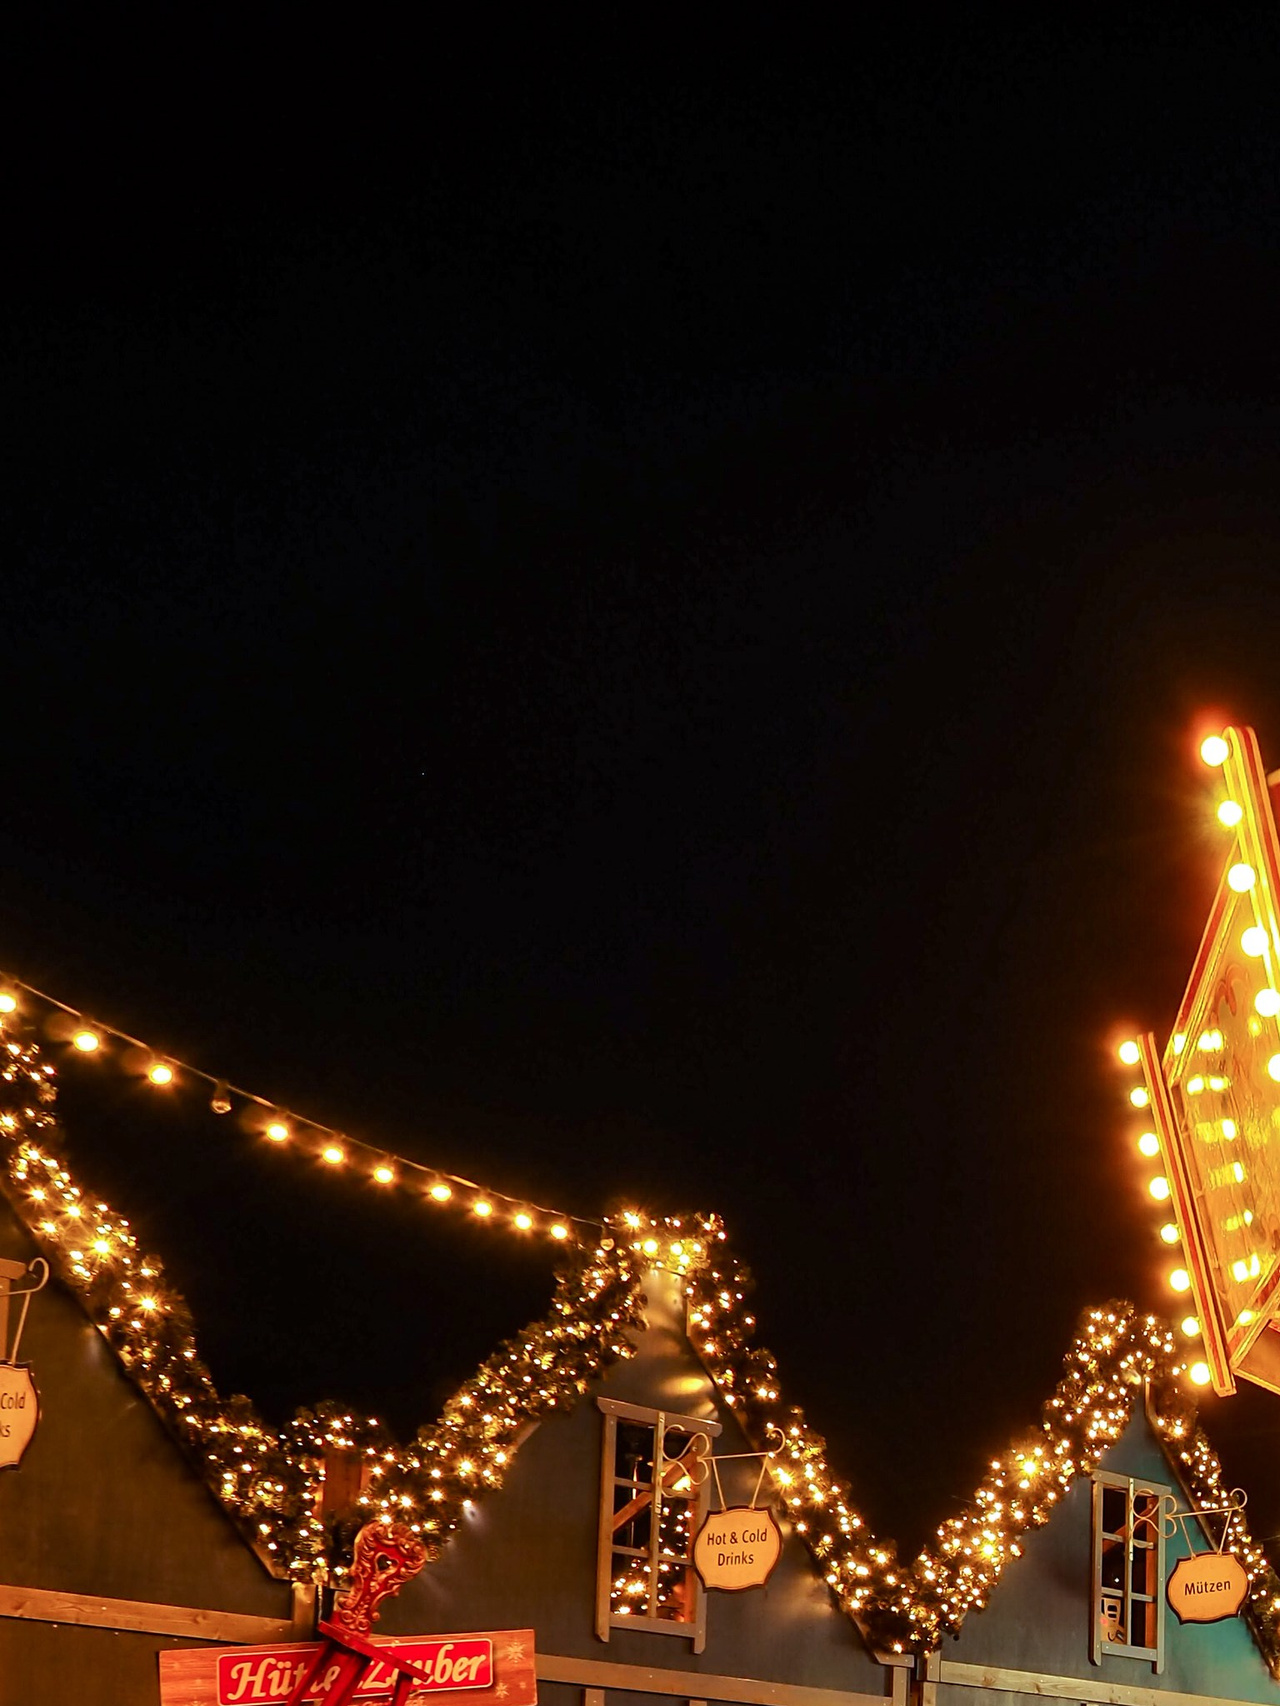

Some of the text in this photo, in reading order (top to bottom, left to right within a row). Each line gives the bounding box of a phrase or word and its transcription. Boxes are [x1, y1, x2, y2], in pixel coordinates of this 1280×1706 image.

[1, 1391, 26, 1410] Cold
[707, 1528, 767, 1546] Hot & Cold
[717, 1551, 754, 1566] Drinks
[1184, 1580, 1231, 1596] Mützen
